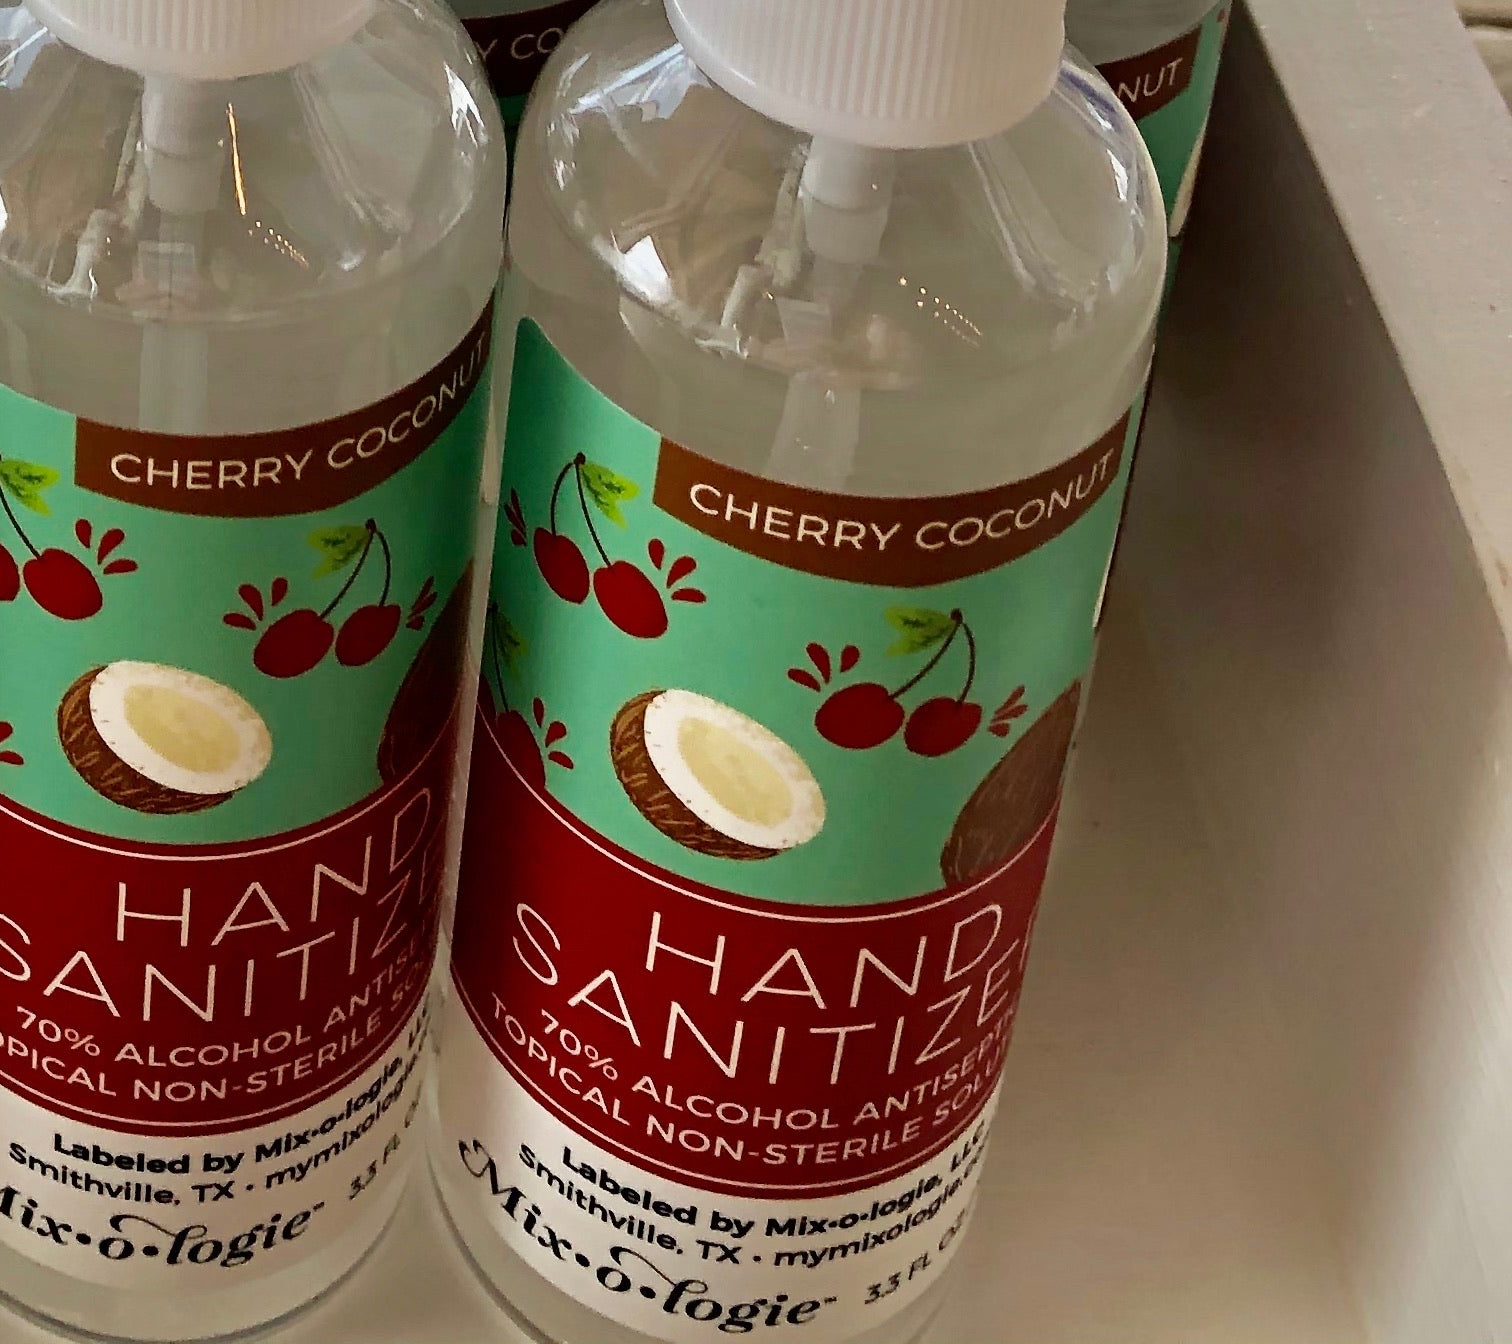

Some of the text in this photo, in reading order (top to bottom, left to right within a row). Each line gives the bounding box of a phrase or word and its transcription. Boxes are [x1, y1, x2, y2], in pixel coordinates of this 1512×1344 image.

[110, 330, 487, 491] CHERRY COCONUT
[688, 448, 1117, 552] CHERRY COCONUT
[115, 787, 431, 948] HAND
[643, 903, 1003, 1010] HAND
[15, 1005, 101, 1058] 70%
[114, 1020, 314, 1069] ALCOHOL
[132, 1005, 383, 1104] NON-STERILE
[490, 991, 630, 1127] TOPICAL
[645, 1115, 924, 1168] NON-STERILE
[539, 1007, 620, 1082] 70%
[630, 1074, 840, 1132] ALCOHOL
[8, 1141, 181, 1207] Smithville,
[191, 1183, 236, 1203] TX
[53, 1132, 190, 1176] Labeled
[201, 1150, 246, 1178] by
[517, 1143, 684, 1255] Smithville,
[695, 1240, 744, 1266] TX
[561, 1145, 698, 1226] Labeled
[708, 1211, 755, 1240] by
